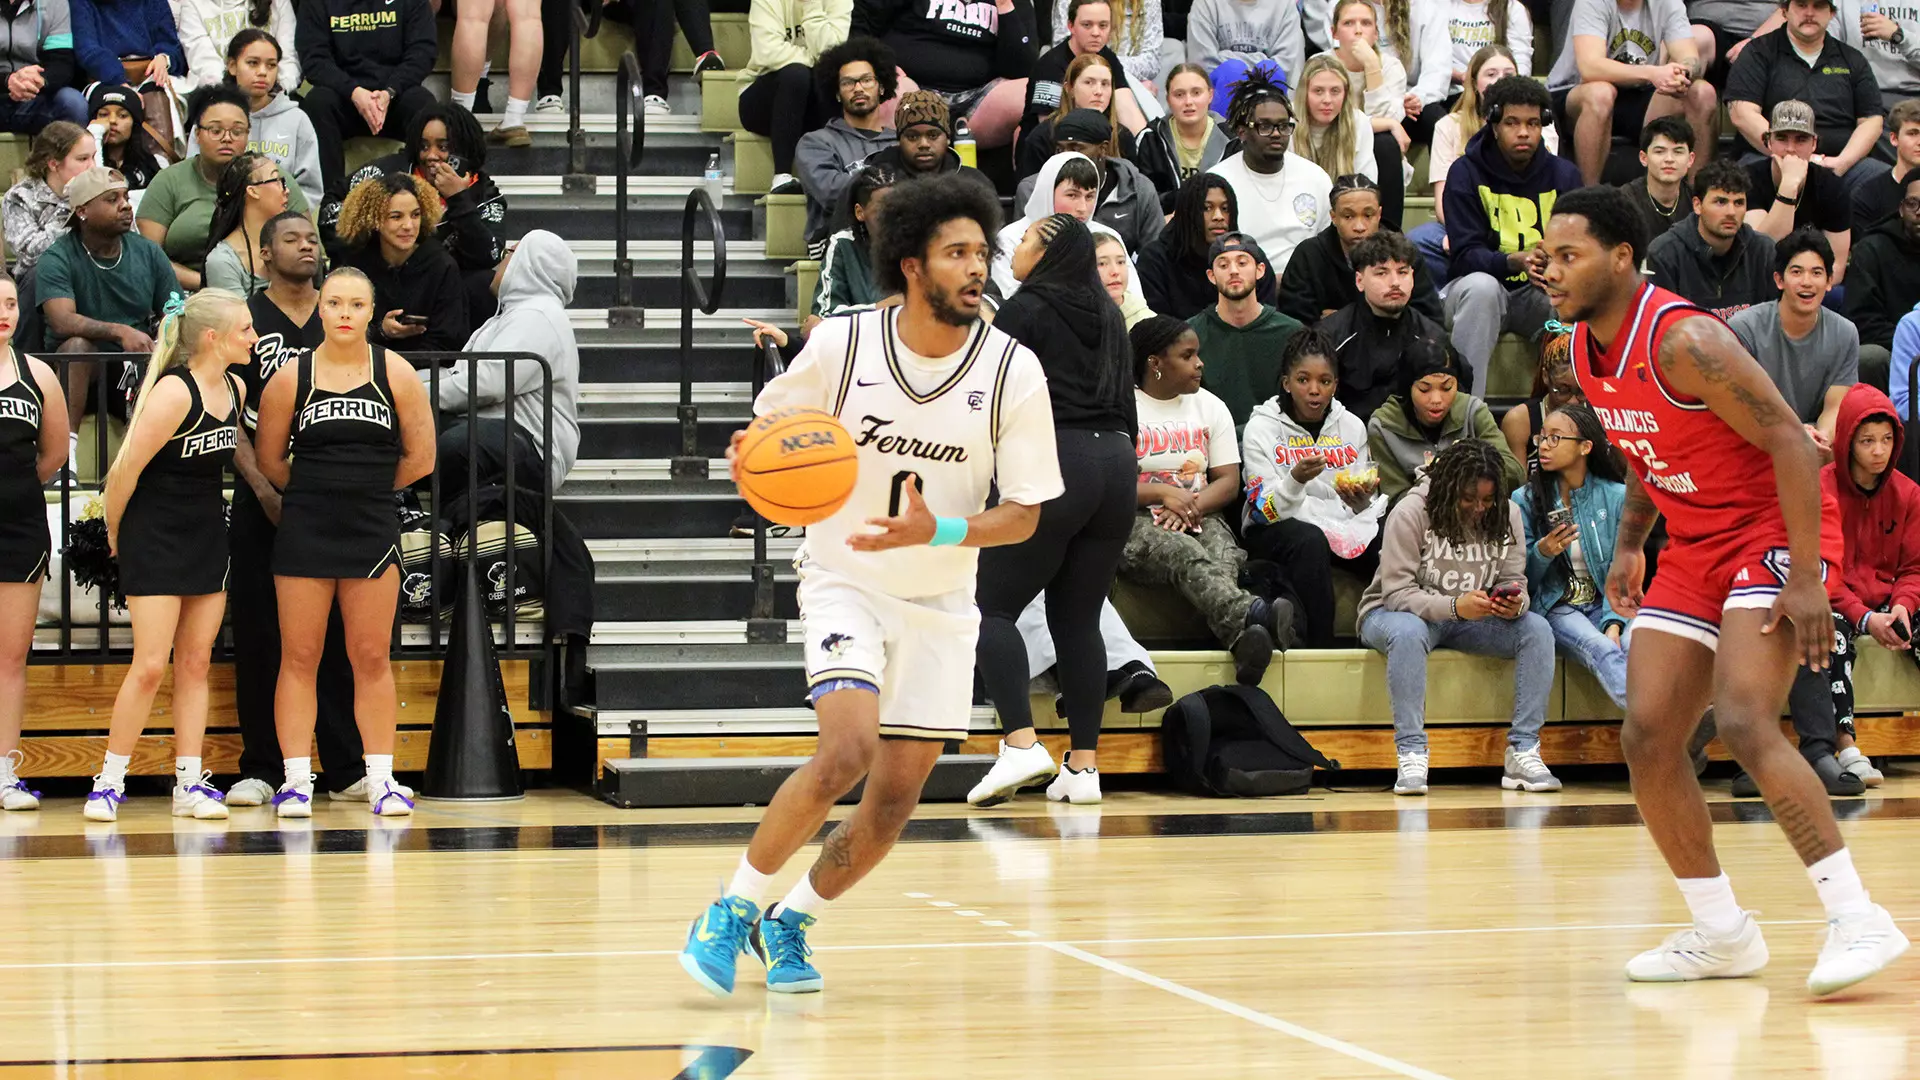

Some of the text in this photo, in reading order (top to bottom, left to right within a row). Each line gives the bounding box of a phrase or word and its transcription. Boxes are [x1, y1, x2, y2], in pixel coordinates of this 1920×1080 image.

[330, 11, 397, 28] FERRUM
[946, 23, 982, 38] COLLEGE
[299, 397, 392, 432] FERRUM
[1593, 406, 1660, 433] FRANCIS
[781, 431, 837, 455] NCAA
[855, 414, 968, 463] Ferrum
